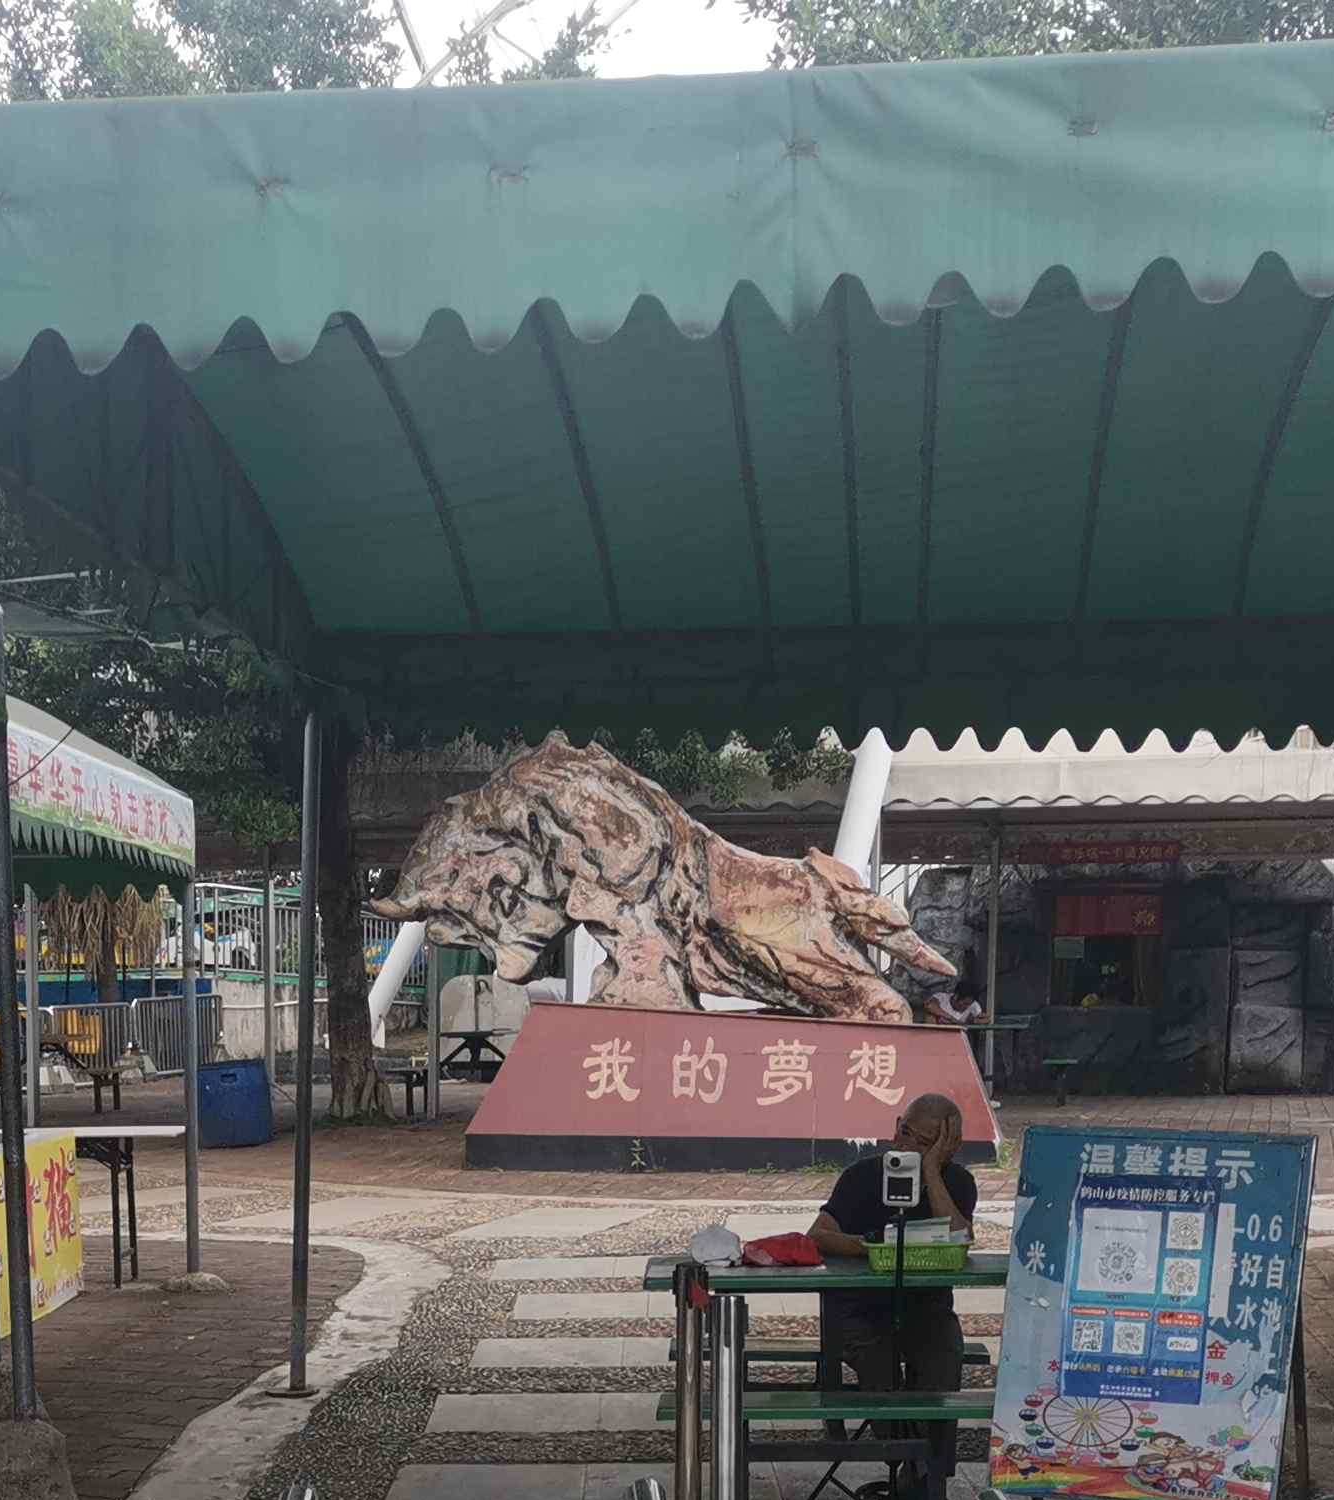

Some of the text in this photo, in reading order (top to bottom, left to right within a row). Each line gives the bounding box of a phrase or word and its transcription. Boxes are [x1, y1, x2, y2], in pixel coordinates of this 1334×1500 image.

[582, 1036, 906, 1106] 我的夢想
[1080, 1143, 1255, 1190] 温馨提示
[1227, 1252, 1286, 1290] 好自
